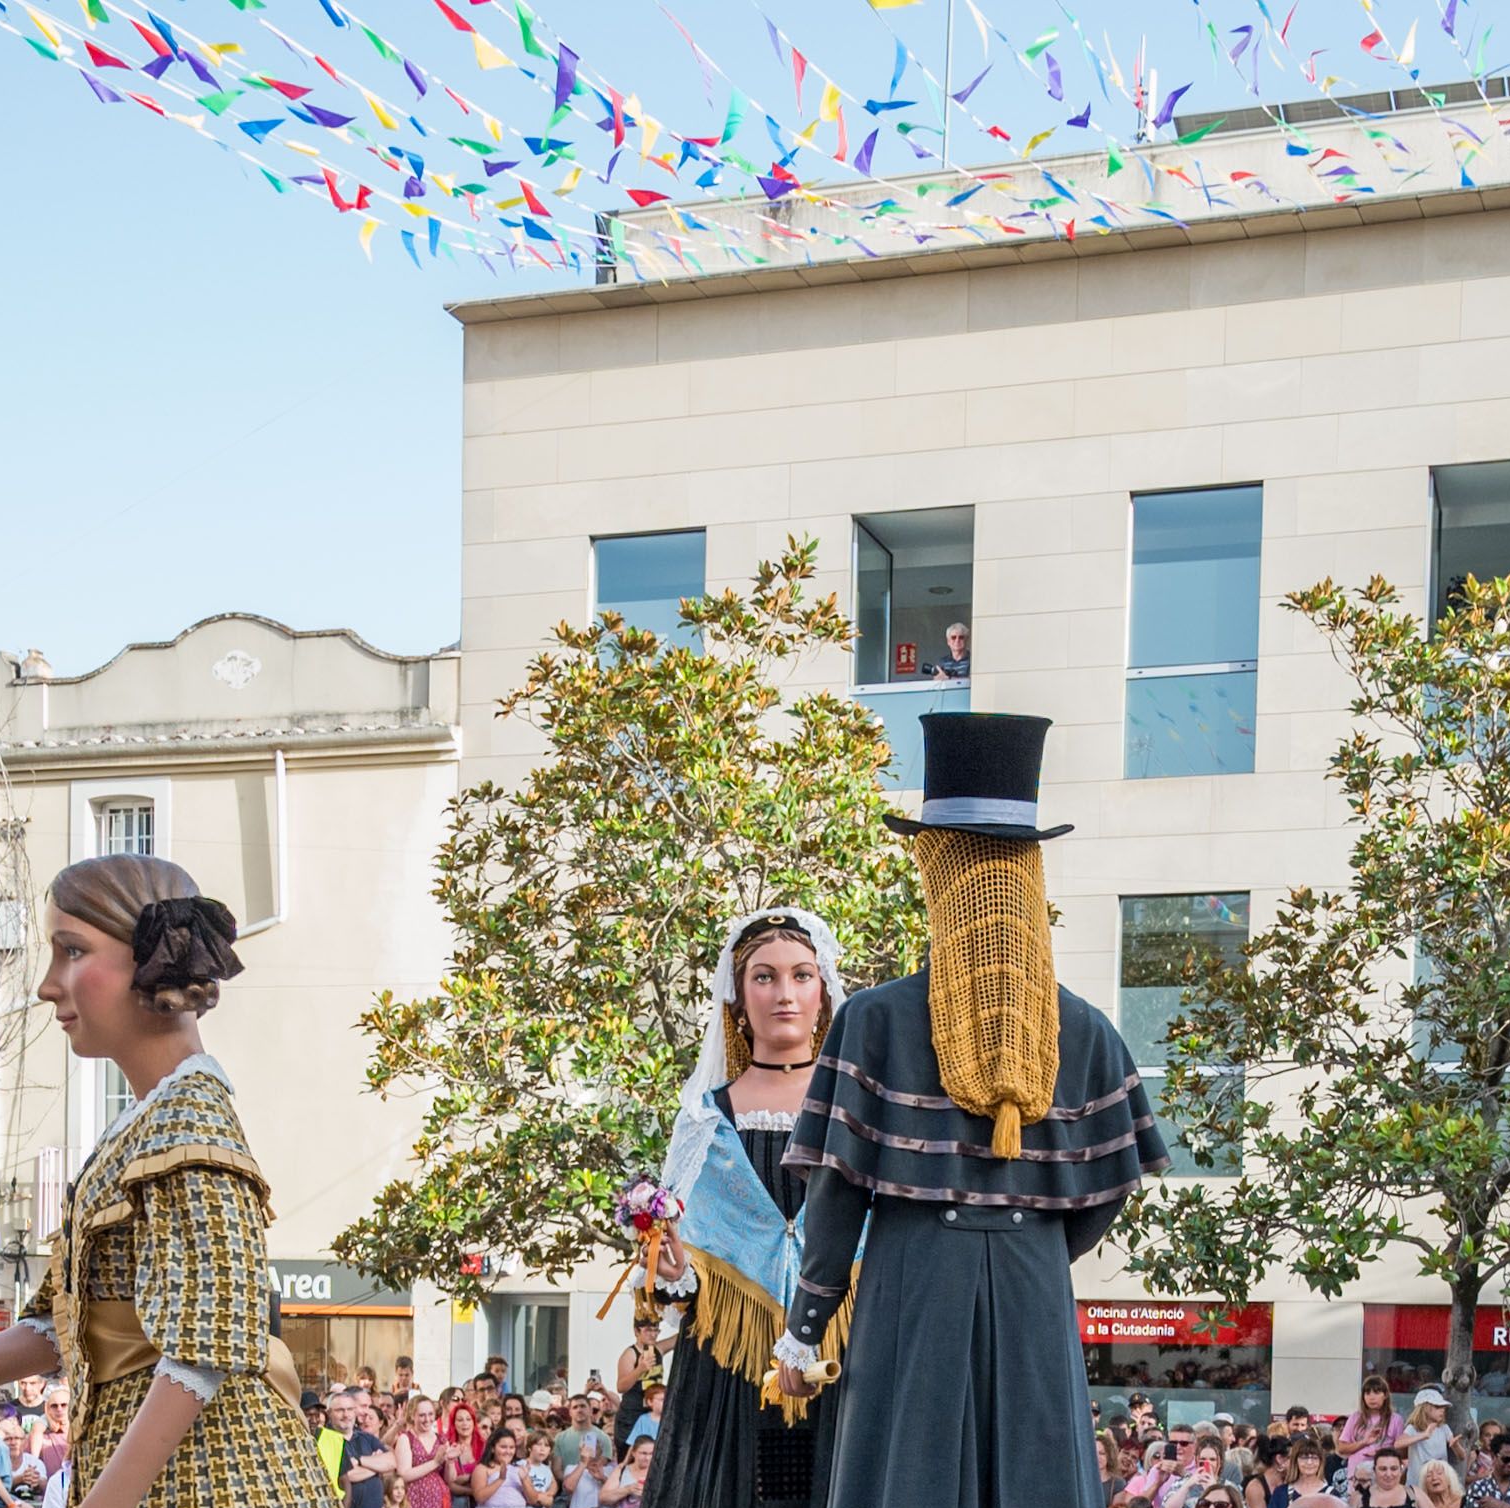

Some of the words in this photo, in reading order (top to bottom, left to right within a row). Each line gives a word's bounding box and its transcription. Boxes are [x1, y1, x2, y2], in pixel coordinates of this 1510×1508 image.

[1087, 1306, 1128, 1319] Oficina
[1130, 1306, 1185, 1320] d'Atenció
[1087, 1326, 1095, 1336] a
[1098, 1323, 1109, 1336] la
[1111, 1322, 1176, 1337] Ciutadania
